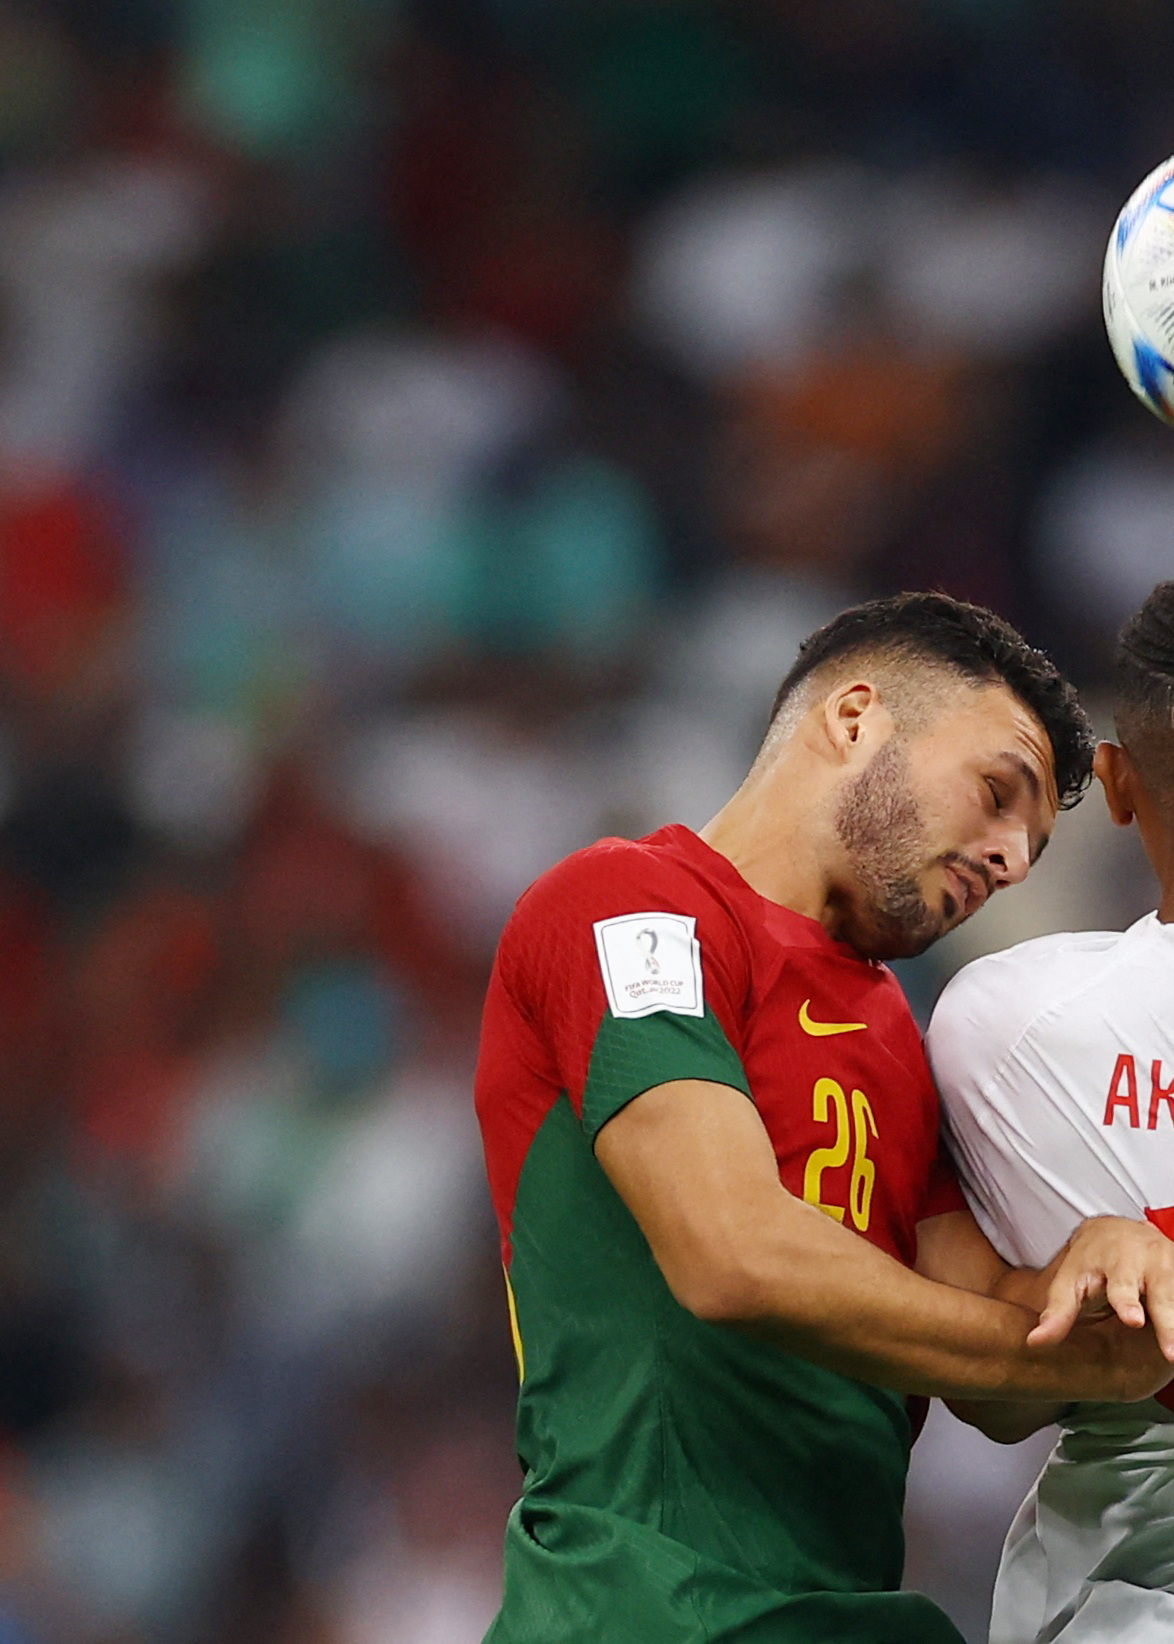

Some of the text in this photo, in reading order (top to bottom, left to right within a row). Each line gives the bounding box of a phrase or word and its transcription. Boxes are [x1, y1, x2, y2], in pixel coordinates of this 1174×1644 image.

[625, 982, 641, 992] FIFA
[659, 987, 682, 995] 2022
[803, 1077, 879, 1232] 26
